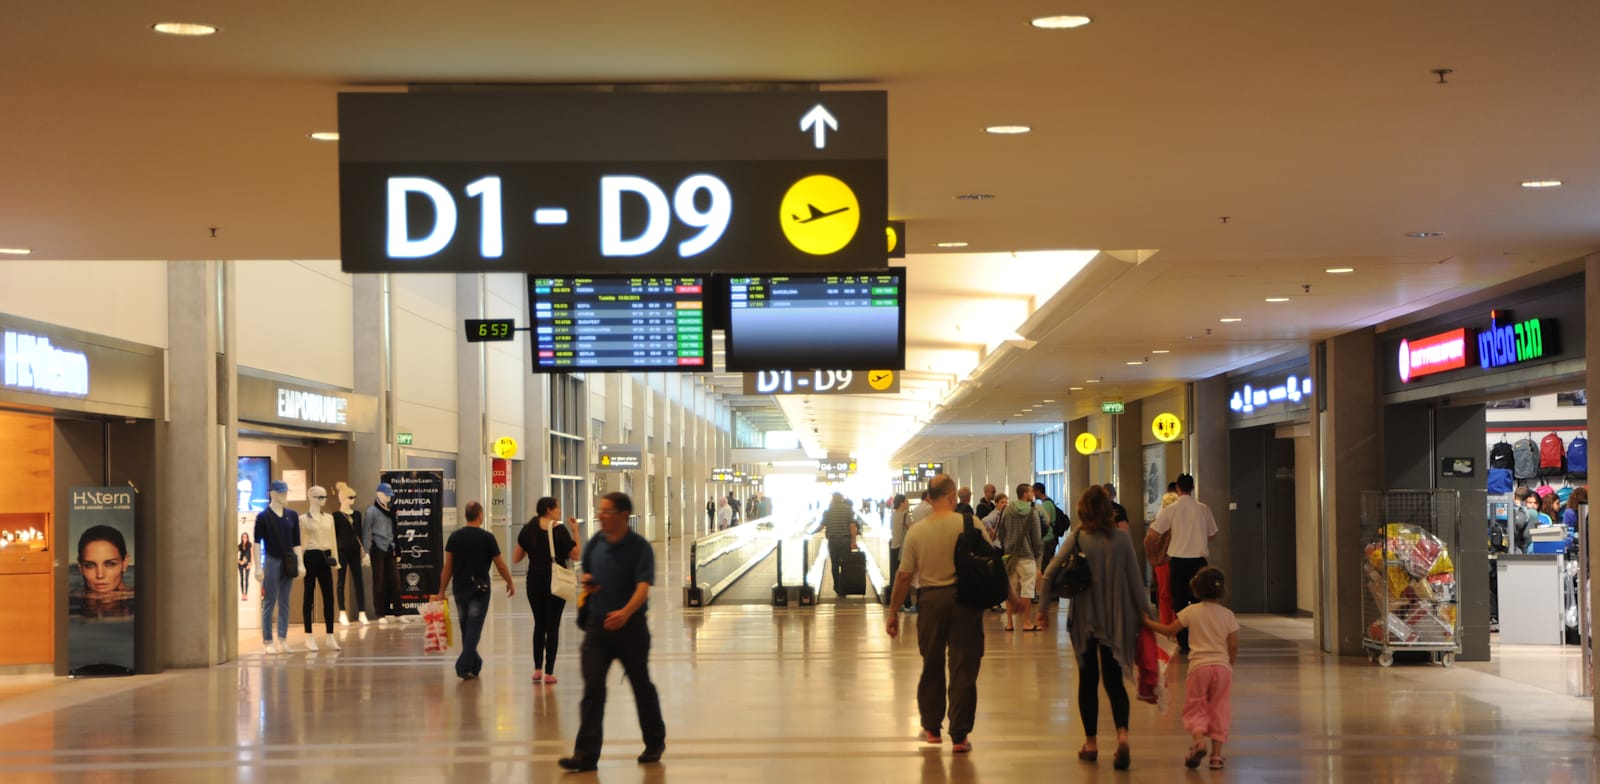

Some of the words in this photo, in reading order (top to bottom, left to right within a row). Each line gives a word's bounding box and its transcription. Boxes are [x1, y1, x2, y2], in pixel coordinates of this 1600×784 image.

[386, 175, 503, 259] D1
[534, 207, 568, 225] -
[600, 173, 732, 259] D9
[757, 370, 792, 392] D1
[814, 370, 853, 391] D9
[277, 388, 337, 423] EMPORIUM
